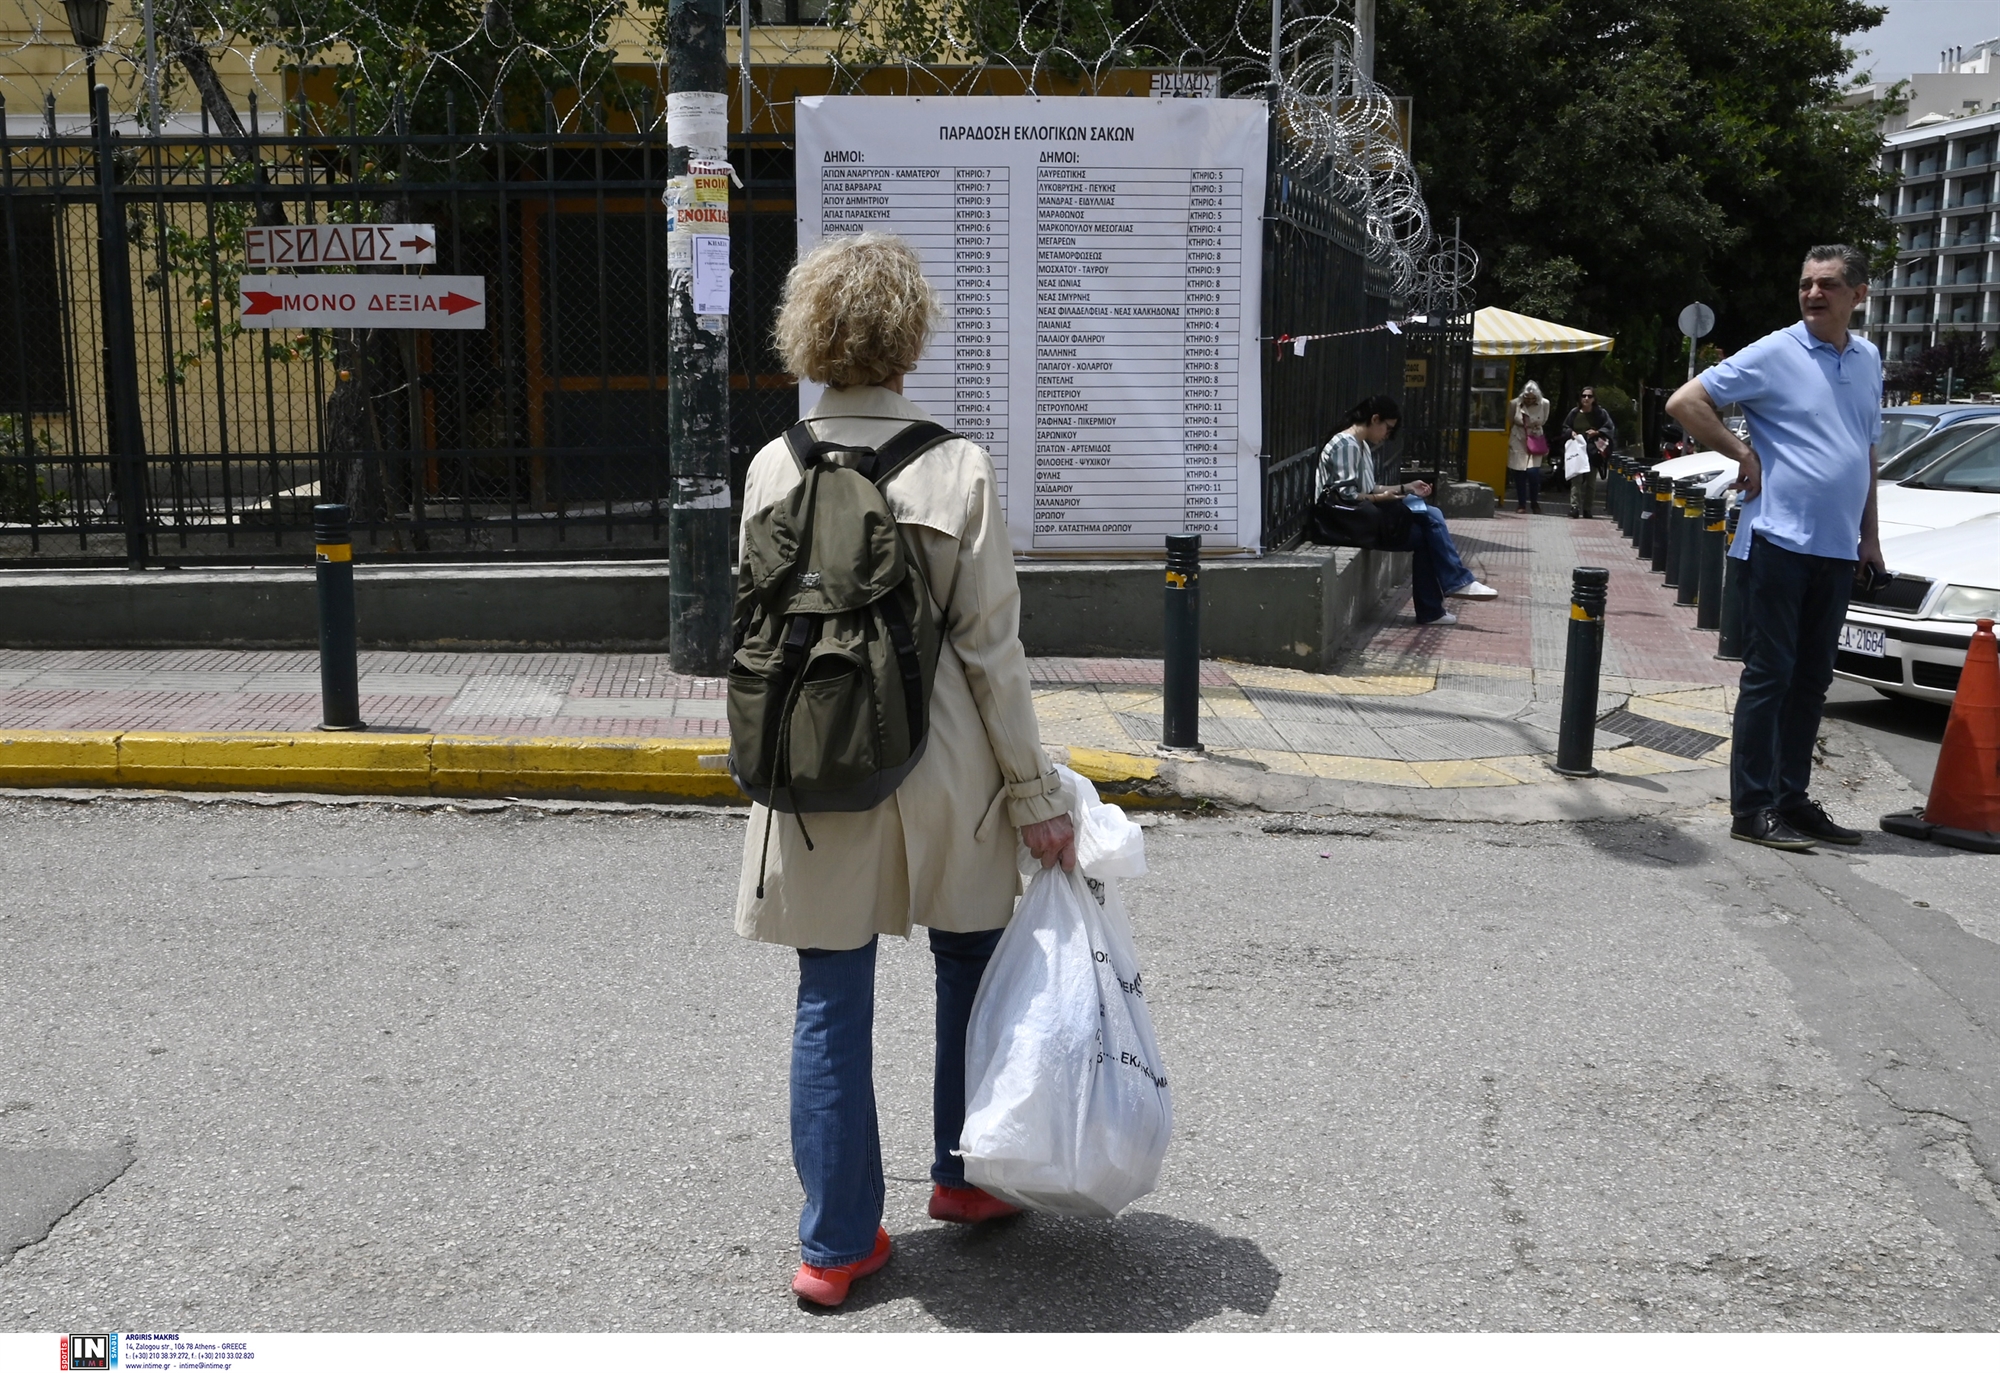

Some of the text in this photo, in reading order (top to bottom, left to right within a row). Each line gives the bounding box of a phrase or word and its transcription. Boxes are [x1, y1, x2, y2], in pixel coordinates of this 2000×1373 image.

[940, 126, 1134, 141] ΠΑΡΑΔΟΣΗ ΕΚΛΟΓΙΚΩΝ ΣΑΚΩΝ
[824, 151, 864, 162] ΔΗΜΟΙ:
[1040, 152, 1079, 163] ΔΗΜΟΙ:
[823, 170, 991, 178] ΑΓΙΩΝ ΑΝΑΡΓΥΡΩΝ ΚΑΜΑΤΕΡΟΥ ΚΤΗΡΙΟ: 7
[1039, 170, 1224, 180] ΛΑΥΡΕΩΤΙΚΗΣ ΚΤΗΡΙΟ: 5
[824, 183, 991, 191] ΑΓΙΑΣ ΒΑΡΒΑΡΑΣ ΚΤΗΡΙΟ: 7
[1039, 184, 1223, 193] ΛΥΚΟΒΡΥΣΗΣ ΠΕΥΚΗΣ ΚΤΗΡΙΟ: 3
[824, 197, 991, 205] ΑΓΙΟΥ ΔΗΜΗΤΡΙΟΥ ΚΤΗΡΙΟ: 9
[1039, 197, 1073, 205] ΜΑΝΔΡΑΣ
[1079, 198, 1114, 206] ΕΙΔΥΛΛΙΑΣ
[1191, 199, 1216, 207] ΚΤΗΡΙΟ:
[824, 210, 991, 219] ΑΓΙΑΣ ΠΑΡΑΣΚΕΥΗΣ ΚΤΗΡΙΟ: 3
[1039, 211, 1223, 220] ΜΑΡΑΘΩΝΟΣ ΚΤΗΡΙΟ: 5
[824, 224, 991, 232] ΑΘΗΝΑΙΩΝ ΚΤΗΡΙΟ: 6
[1039, 224, 1222, 233] ΜΑΡΚΟΠΟΥΛΟΥ ΜΕΣΟΓΑΙΑΣ ΚΤΗΡΙΟ: 4
[246, 227, 397, 263] ΕΙΣΟΔΟΣ
[1039, 237, 1075, 245] ΜΕΓΑΡΕΩΝ
[1189, 239, 1215, 247] ΚΤΗΡΙΟ:
[1039, 251, 1222, 260] ΜΕΤΑΜΟΡΦΩΣΕΩΣ ΚΤΗΡΙΟ: 8
[1038, 265, 1221, 274] ΜΟΣΧΑΤΟΥ ΤΑΥΡΟΥ ΚΤΗΡΙΟ: 9
[1038, 279, 1221, 288] ΝΕΑΣ ΙΩΝΙΑΣ ΚΤΗΡΙΟ: 8
[1038, 293, 1221, 302] ΝΕΑΣ ΣΜΥΡΝΗΣ ΚΤΗΡΙΟ: 9
[284, 294, 437, 311] ΜΟΝΟ ΔΕΞΙΑ
[1038, 307, 1220, 316] ΝΕΑΣ ΦΙΛΑΔΕΛΦΕΙΑΣ ΝΕΑΣ ΧΑΛΚΗΔΟΝΑΣ ΚΤΗΡΙΟ: 8
[1038, 321, 1071, 329] ΠΑΙΑΝΙΑΣ
[1186, 322, 1213, 330] ΚΤΗΡΙΟ:
[1038, 335, 1220, 343] ΠΑΛΑΙΟΥ ΦΑΛΗΡΟΥ ΚΤΗΡΙΟ: 9
[1038, 349, 1076, 357] ΠΑΛΛΗΝΗΣ
[1186, 349, 1212, 357] ΚΤΗΡΙΟ:
[1038, 362, 1219, 371] ΠΑΠΑΓΟΥ ΧΟΛΑΡΓΟΥ ΚΤΗΡΙΟ: 8
[1038, 376, 1219, 385] ΠΕΝΤΕΛΗΣ ΚΤΗΡΙΟ: 8
[1038, 390, 1081, 398] ΠΕΡΙΣΤΕΡΙΟΥ
[1185, 390, 1212, 398] ΚΤΗΡΙΟ:
[1038, 403, 1222, 412] ΠΕΤΡΟΥΠΟΛΗΣ ΚΤΗΡΙΟ: 11
[1038, 418, 1072, 426] ΡΑΦΗΝΑΣ
[1078, 418, 1116, 426] ΠΙΚΕΡΜΙΟΥ
[1185, 417, 1212, 425] ΚΤΗΡΙΟ:
[1037, 430, 1218, 439] ΣΑΡΩΝΙΚΟΥ ΚΤΗΡΙΟ: 4
[1037, 445, 1065, 453] ΣΠΑΤΩΝ
[1071, 445, 1111, 453] ΑΡΤΕΜΙΔΟΣ
[1185, 444, 1212, 452] ΚΤΗΡΙΟ:
[1037, 457, 1218, 466] ΦΙΛΟΘΕΗΣ ΨΥΧΙΚΟΥ ΚΤΗΡΙΟ: 8
[1036, 472, 1060, 480] ΦΥΛΗΣ
[1187, 471, 1211, 479] ΚΤΗΡΙΟ:
[1035, 484, 1221, 493] ΧΑΪΔΑΡΙΟΥ ΚΤΗΡΙΟ: 11
[1036, 497, 1219, 507] ΧΑΛΑΝΔΡΙΟΥ ΚΤΗΡΙΟ: 8
[1036, 512, 1065, 520] ΩΡΩΠΟΥ
[1186, 511, 1212, 519] ΚΤΗΡΙΟ:
[1034, 525, 1056, 533] ΣΩΦΡ.
[1059, 525, 1100, 533] ΚΑΤΑΣΤΗΜΑ
[1102, 524, 1132, 532] ΩΡΩΠΟΥ
[1185, 524, 1212, 532] ΚΤΗΡΙΟ:
[1857, 628, 1884, 653] 21664
